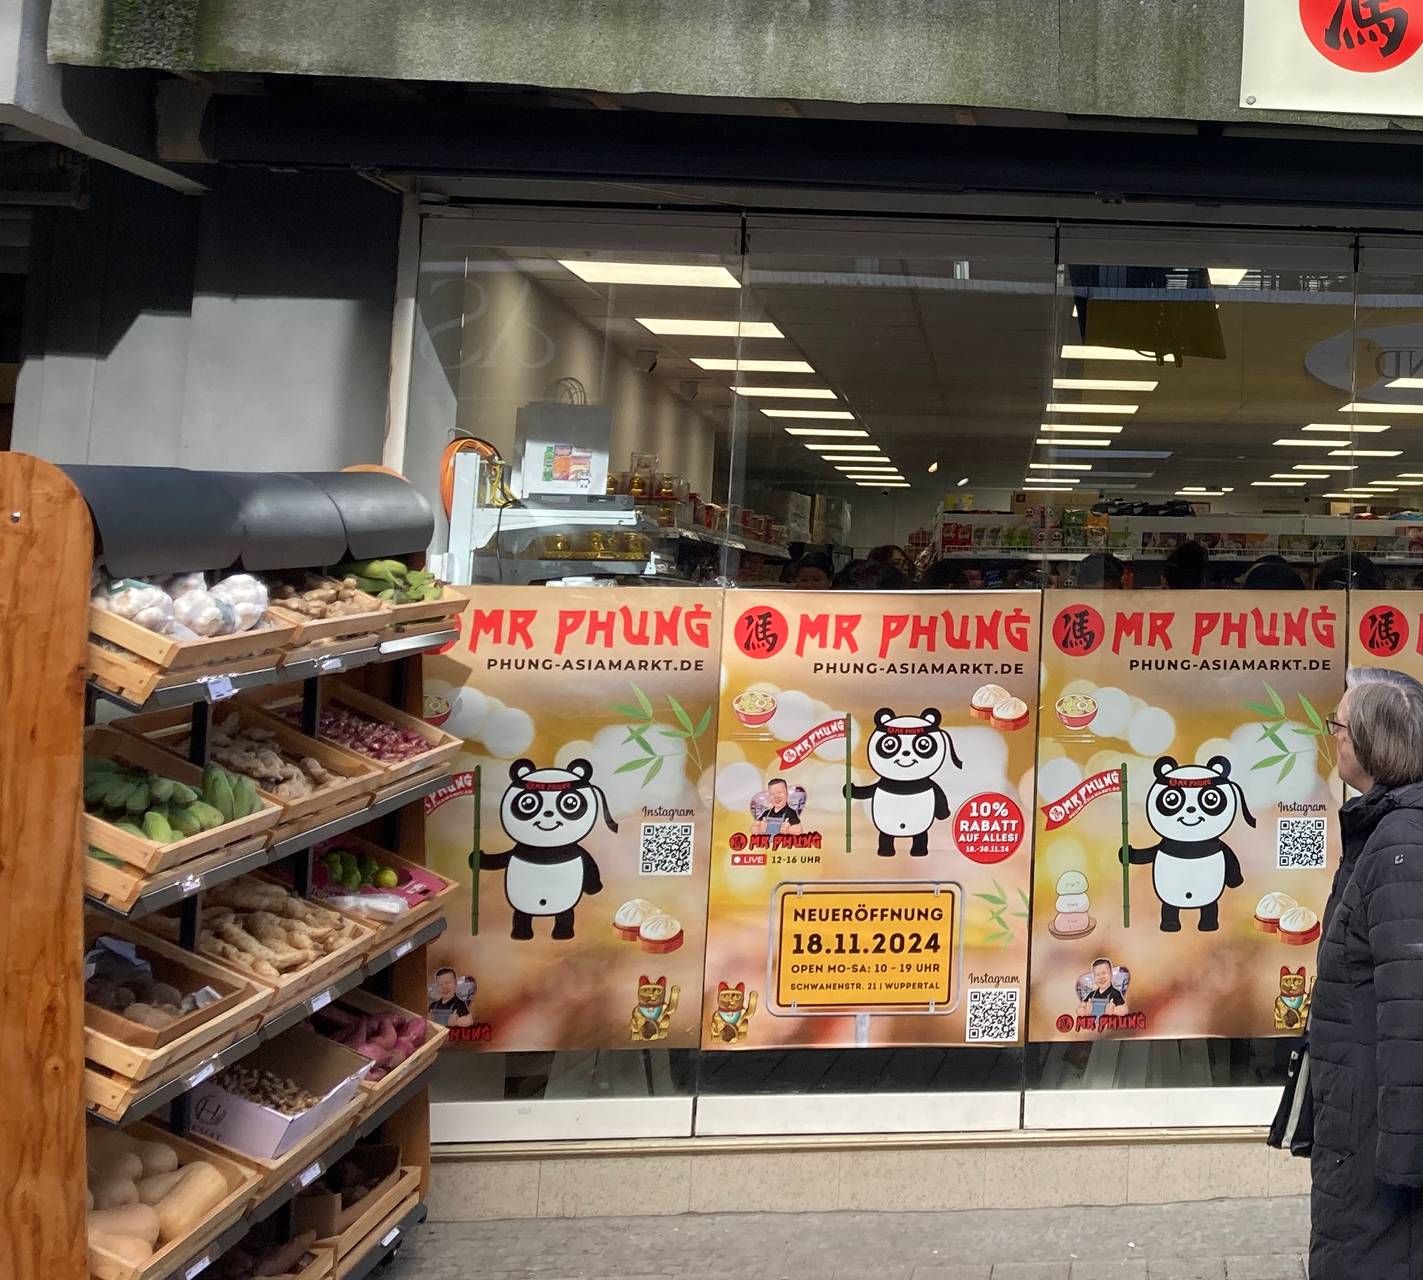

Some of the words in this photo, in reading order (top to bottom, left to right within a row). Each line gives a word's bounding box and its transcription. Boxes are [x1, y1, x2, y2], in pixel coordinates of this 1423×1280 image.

[468, 610, 537, 654] MR
[554, 603, 711, 655] PHUNG
[795, 614, 861, 658] MR
[878, 607, 1031, 659] PHUNG
[1112, 612, 1175, 656] MR
[1192, 605, 1336, 656] PHUNG
[487, 658, 704, 672] PHUNG-ASIAMARKT.DE
[813, 663, 1024, 675] PHUNG-ASIAMARKT.DE
[1129, 659, 1331, 671] PHUNG-ASIAMARKT.DE
[810, 720, 844, 746] PHUNG
[1079, 771, 1119, 803] PHUNG
[641, 805, 695, 820] Instagram
[970, 802, 1009, 817] 10%
[1277, 801, 1327, 816] Instagram
[960, 820, 1018, 831] RABATT
[958, 834, 979, 842] AUF
[982, 834, 1018, 842] ALLES!
[771, 856, 797, 864] 12-16
[800, 856, 821, 864] UHR
[793, 904, 944, 922] NEUERÖFFNUNG
[792, 933, 941, 954] 18.11.2024
[791, 965, 823, 973] OPEN
[828, 964, 871, 973] MO-SA:
[874, 964, 887, 972] 10
[900, 964, 912, 972] 19
[916, 964, 940, 972] UHR
[885, 982, 940, 990] WUPPERTAL
[968, 973, 1020, 988] Instagram
